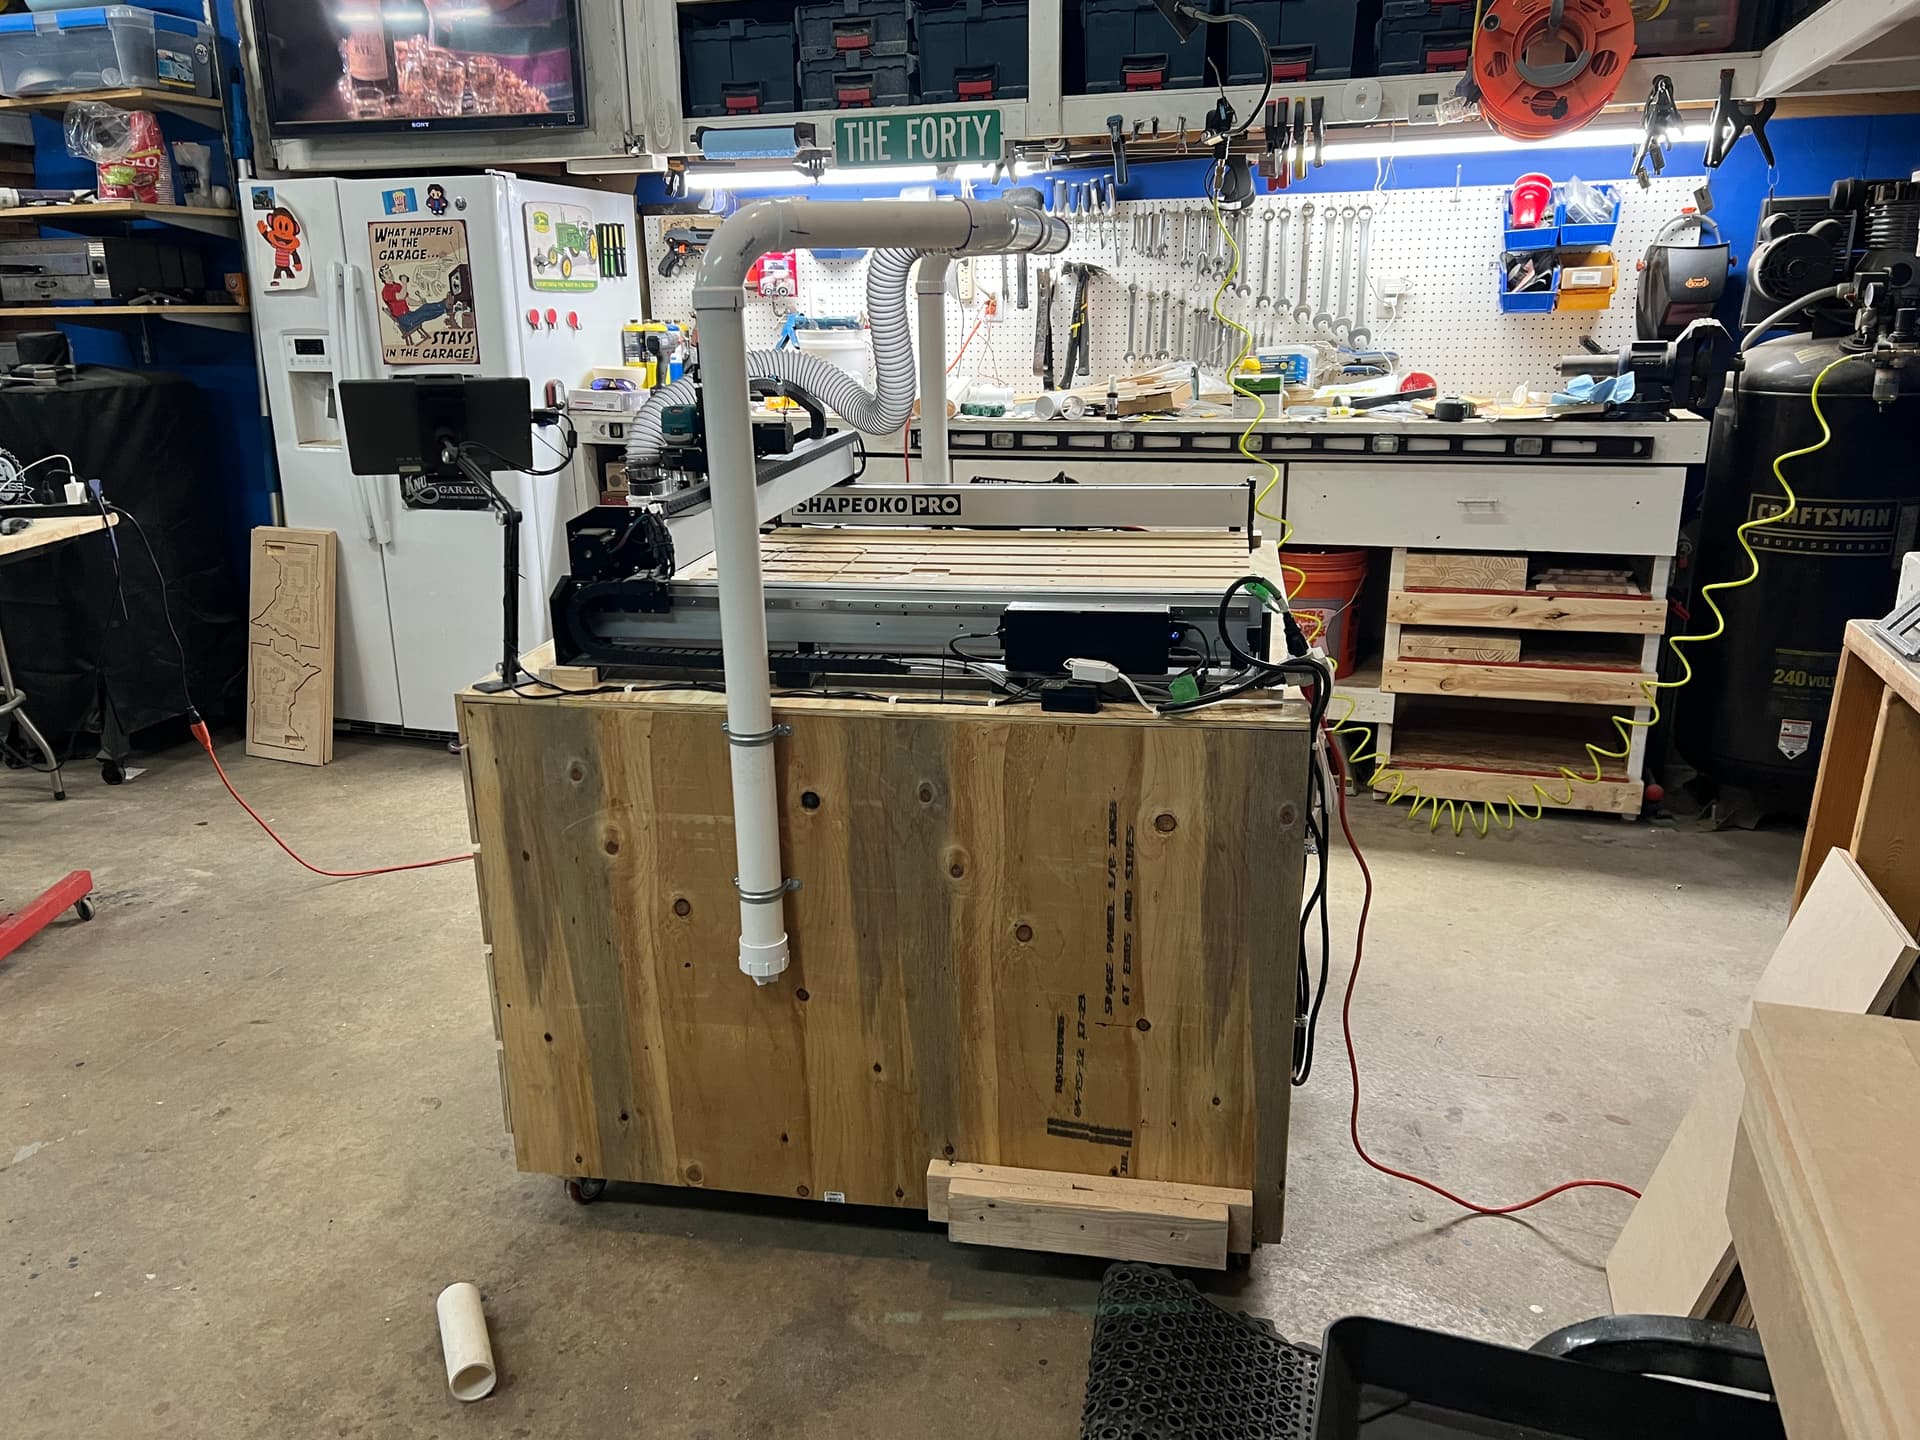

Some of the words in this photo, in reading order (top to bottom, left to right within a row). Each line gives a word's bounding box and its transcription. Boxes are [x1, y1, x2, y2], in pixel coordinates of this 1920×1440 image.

[843, 120, 891, 162] THE
[906, 115, 992, 160] FORTY
[117, 156, 158, 168] OLO
[375, 226, 407, 243] WHAT
[409, 226, 455, 236] HAPPENS
[388, 238, 398, 248] IN
[401, 237, 418, 248] THE
[379, 249, 439, 261] GARAGE...
[432, 330, 474, 345] STAYS
[385, 348, 396, 358] IN
[400, 347, 419, 358] THE
[422, 345, 475, 360] GARAGE!
[796, 497, 908, 513] SHAPEOKO
[915, 496, 959, 513] PRO
[1757, 504, 1892, 527] CRAFTSMAN
[1772, 669, 1808, 687] 240
